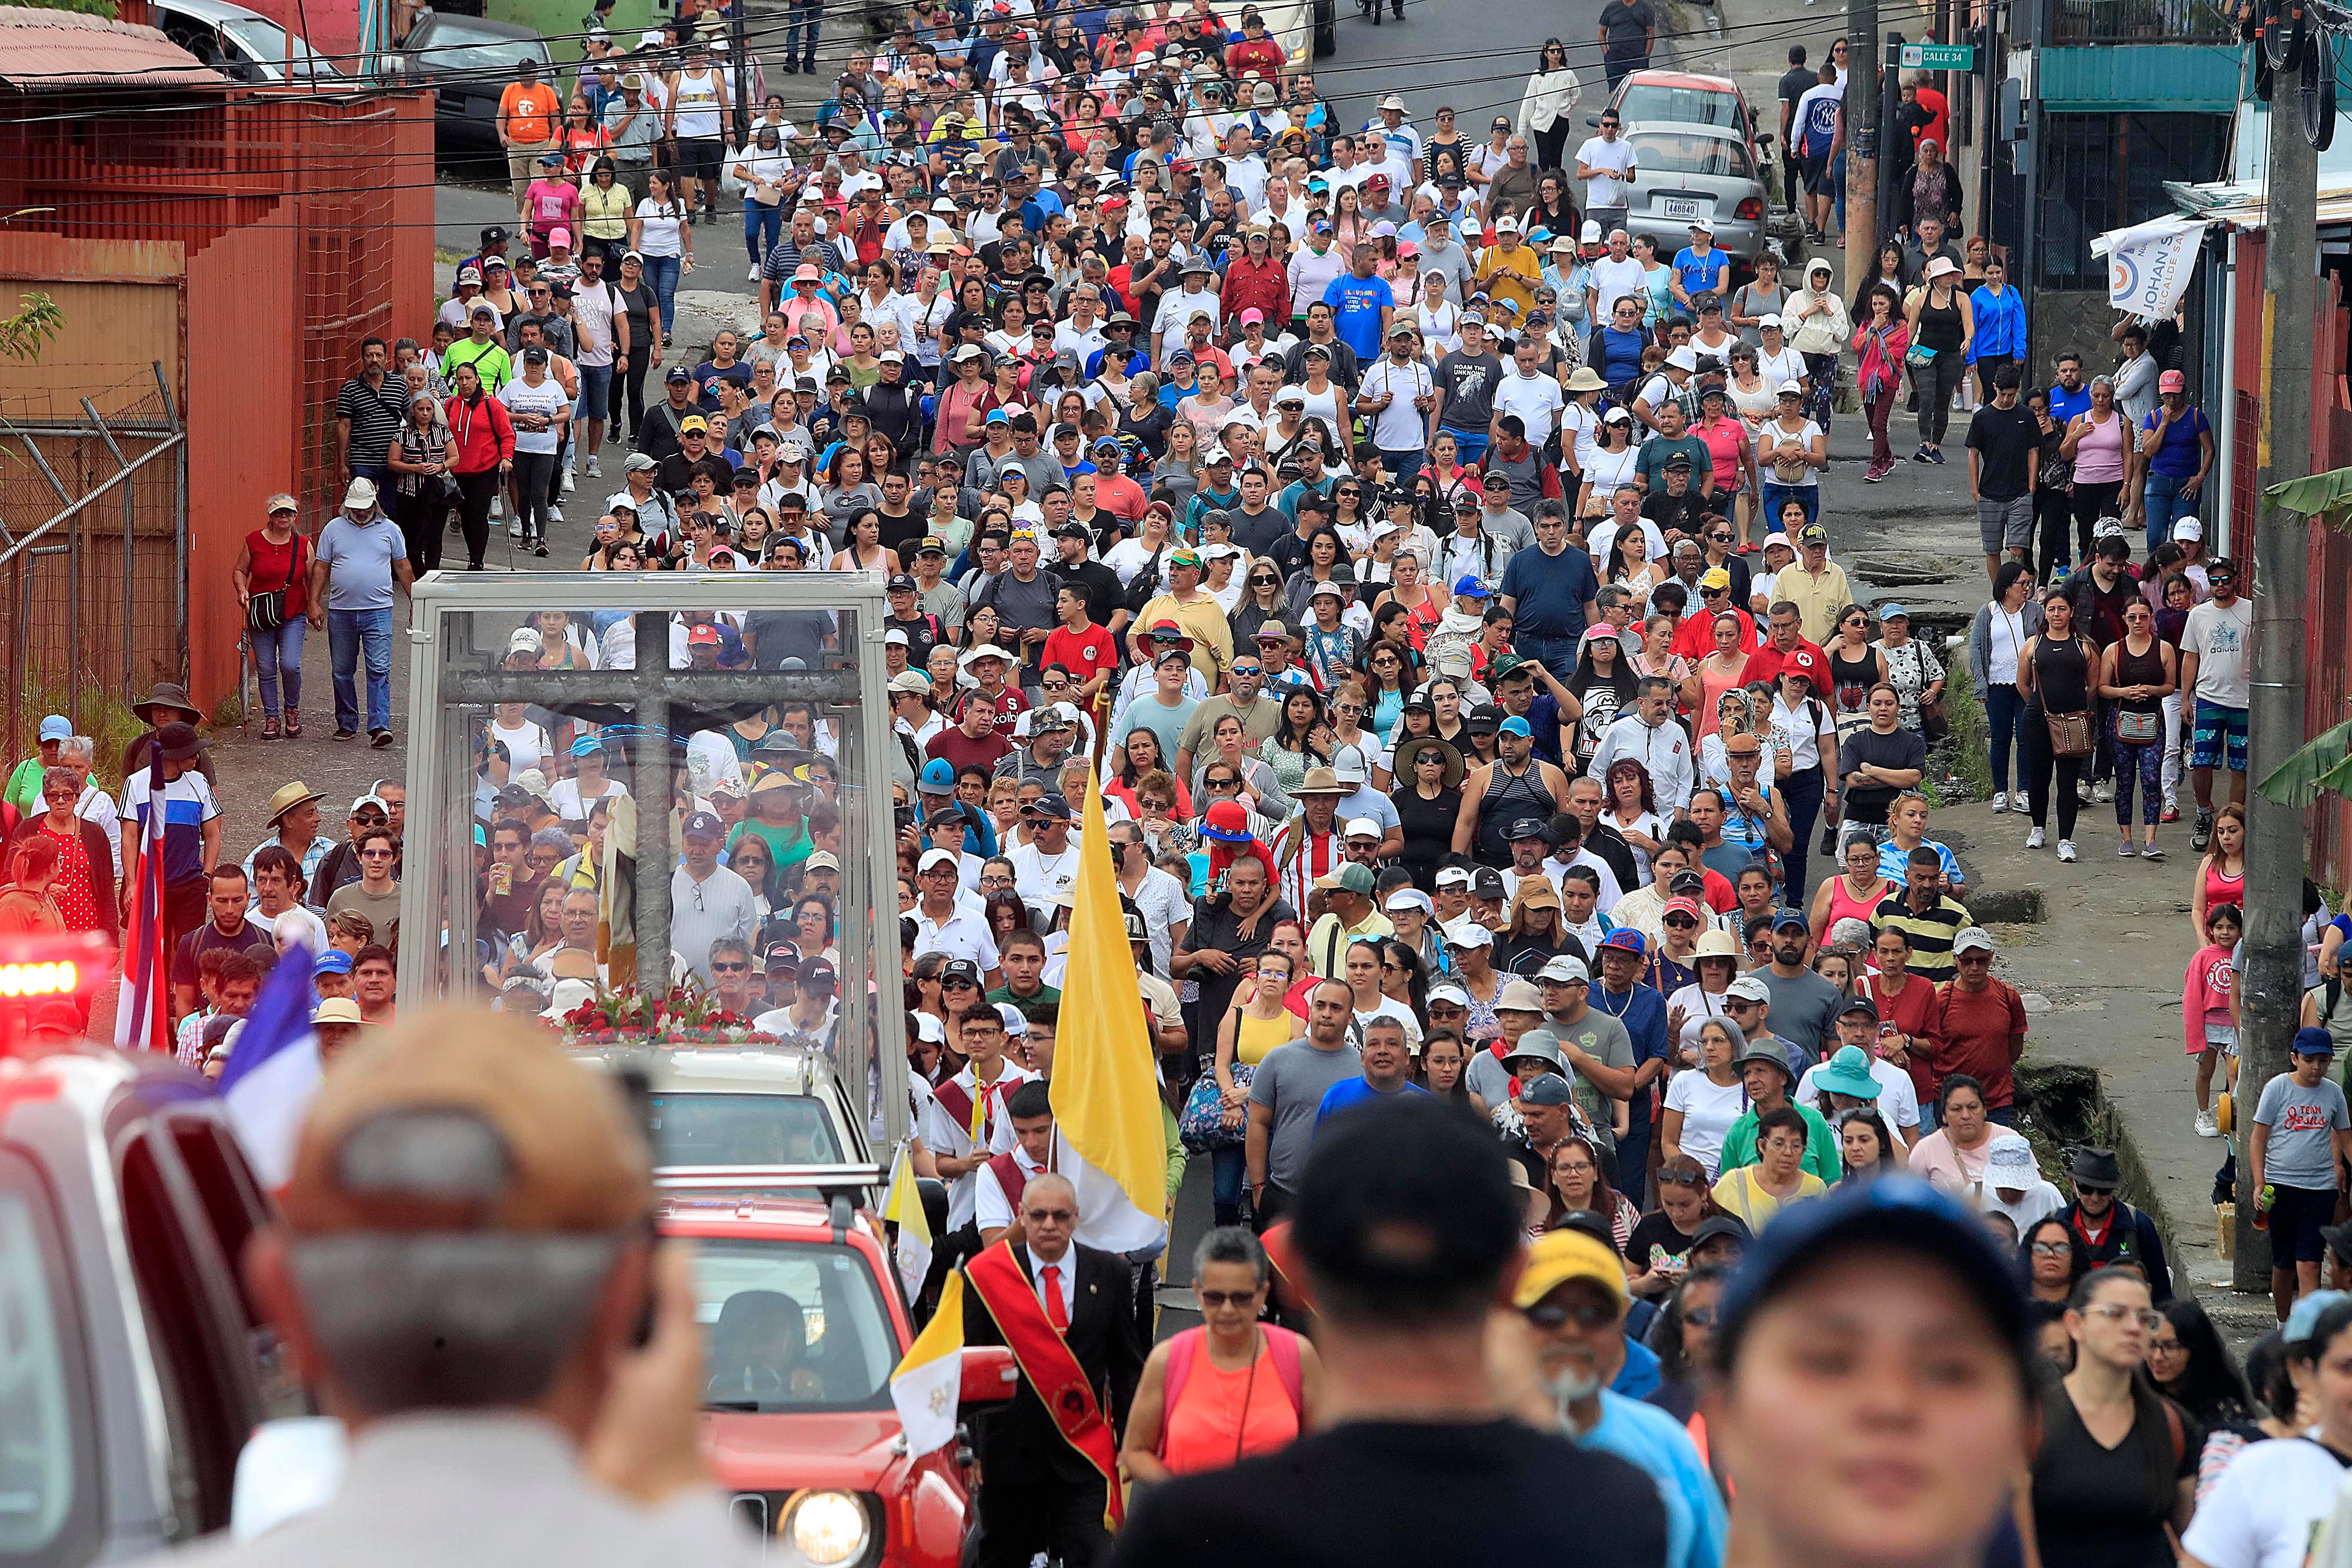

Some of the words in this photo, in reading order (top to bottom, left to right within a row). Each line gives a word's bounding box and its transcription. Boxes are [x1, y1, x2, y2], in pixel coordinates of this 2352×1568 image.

[1923, 52, 1949, 62] CALLE
[1952, 54, 1962, 62] 34
[1669, 204, 1695, 213] 448840
[1213, 235, 1230, 243] XTR
[2143, 250, 2169, 312] JOHAN
[2157, 258, 2177, 313] ALCALDE
[1806, 527, 1816, 536] 46
[1007, 698, 1018, 710] S
[2300, 1106, 2322, 1115] TEAM
[2284, 1106, 2327, 1129] Jesus
